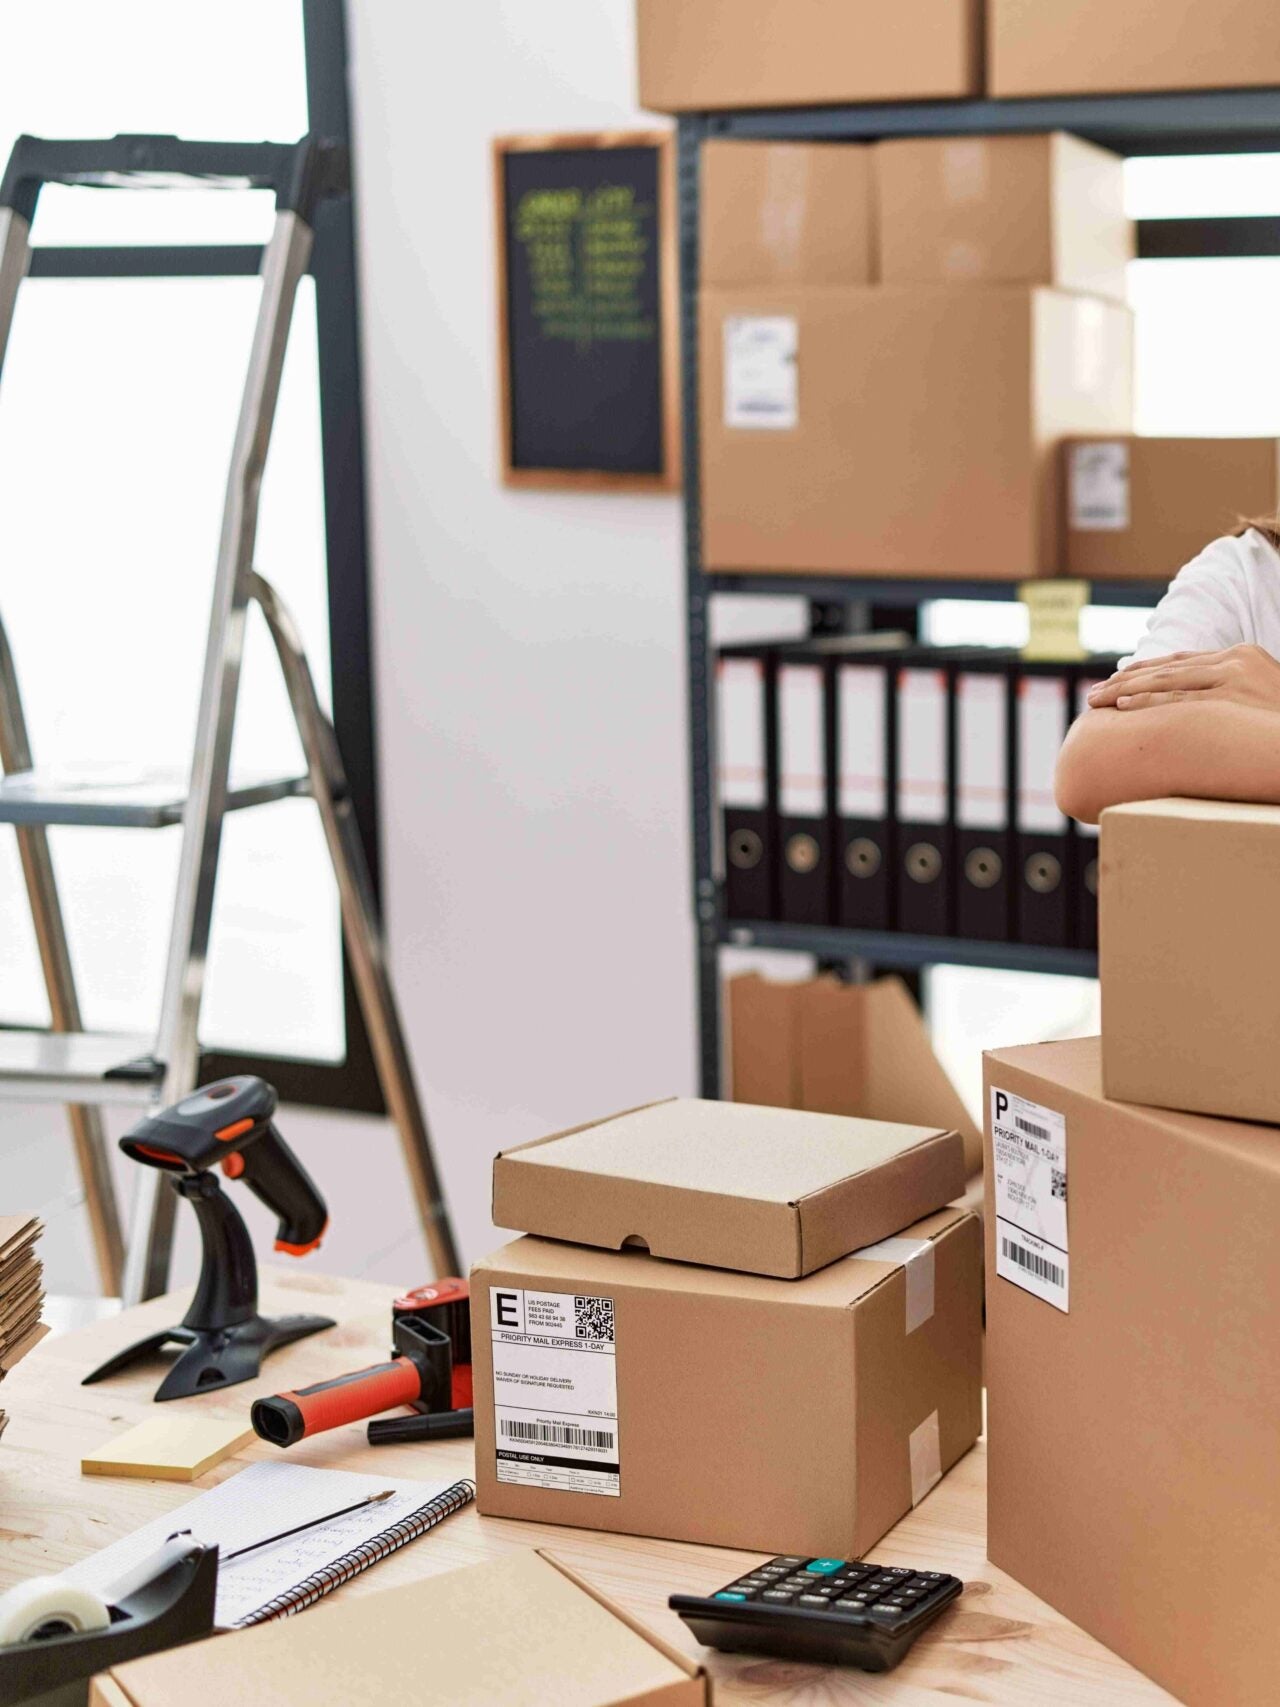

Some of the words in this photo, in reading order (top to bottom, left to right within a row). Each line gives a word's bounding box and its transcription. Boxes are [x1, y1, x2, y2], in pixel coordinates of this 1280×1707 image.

[996, 1091, 1008, 1120] P
[994, 1126, 1023, 1145] PRIORITY
[1025, 1140, 1039, 1154] MAIL
[1041, 1148, 1059, 1162] 1-DAY
[496, 1293, 518, 1327] E
[501, 1333, 532, 1342] PRIORITY
[533, 1336, 549, 1345] MAIL
[551, 1339, 583, 1348] EXPRESS
[585, 1343, 605, 1351] 1-DAY
[520, 1379, 546, 1387] SIGNATURE
[546, 1382, 575, 1391] REQUESTED
[529, 1374, 549, 1382] HOLIDAY
[550, 1376, 572, 1384] DELIVERY
[498, 1451, 518, 1459] POSTAL
